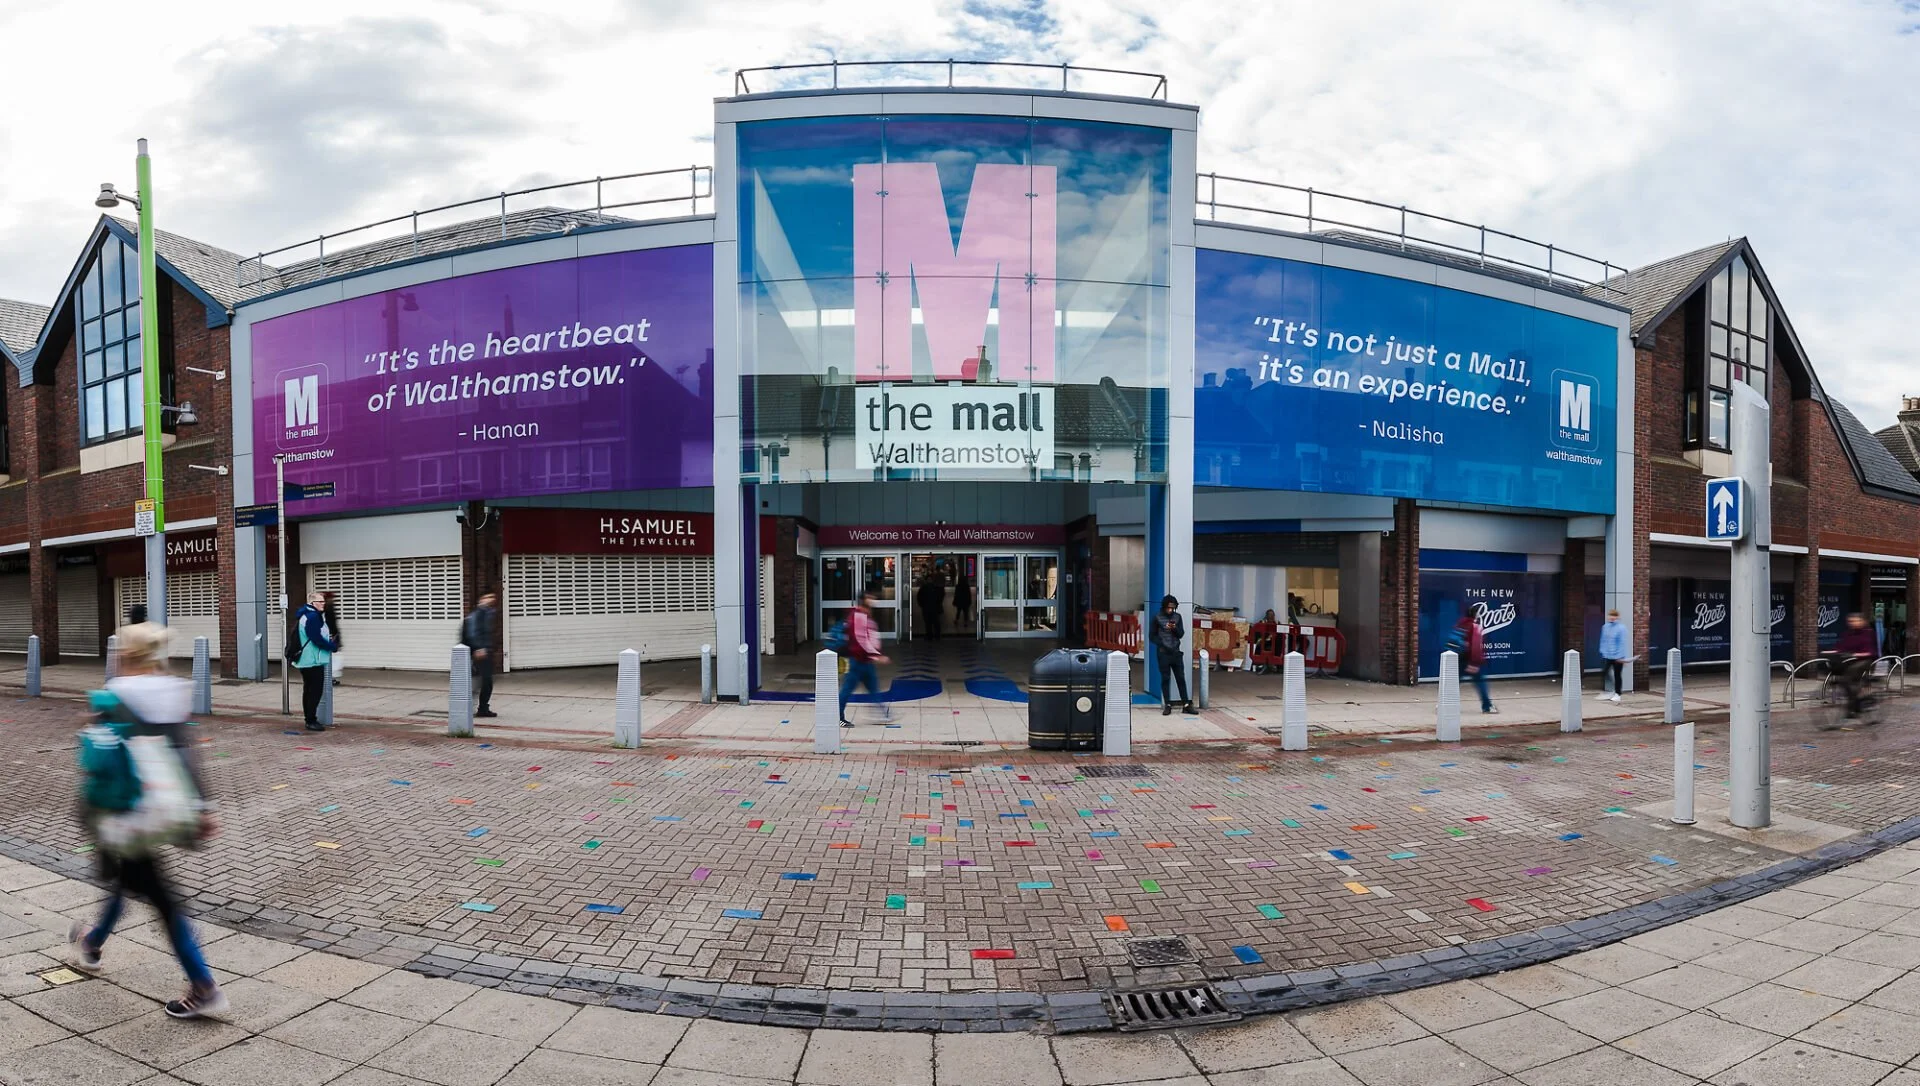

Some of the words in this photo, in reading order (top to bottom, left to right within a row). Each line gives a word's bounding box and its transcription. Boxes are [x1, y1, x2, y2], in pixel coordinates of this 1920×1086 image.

[853, 162, 1057, 383] M
[428, 339, 476, 366] the
[484, 318, 651, 359] heartbeat
[1327, 333, 1378, 357] not
[1380, 335, 1438, 366] just
[1444, 351, 1461, 371] a
[1468, 351, 1531, 387] Mall,
[367, 384, 398, 412] of
[404, 356, 648, 408] Walthamstow."
[1259, 354, 1305, 385] it's
[1313, 367, 1350, 390] an
[1358, 374, 1527, 415] experience."
[284, 374, 319, 429] M
[865, 392, 932, 432] the
[951, 392, 1044, 432] mall
[1559, 379, 1591, 431] M
[286, 429, 299, 440] the
[301, 425, 319, 438] mall
[473, 422, 539, 441] Hanan
[1373, 420, 1444, 445] Nalisha
[1559, 428, 1572, 440] the
[1573, 432, 1590, 443] mall
[271, 448, 335, 465] wlthamstow
[868, 442, 1042, 465] Walthamstow
[1545, 449, 1603, 467] walthamstow
[600, 517, 697, 536] H.SAMUEL
[848, 529, 899, 541] Welcome
[902, 529, 913, 541] to
[915, 529, 936, 541] The
[938, 529, 960, 541] Mall
[963, 529, 1035, 541] Walthamstow
[601, 536, 625, 545] THE
[633, 537, 696, 548] JEWELLER
[1466, 589, 1486, 597] THE
[1491, 589, 1514, 598] NEW
[1692, 591, 1707, 600] THE
[1709, 592, 1725, 600] NEW
[1690, 602, 1727, 630] Boots
[1494, 642, 1512, 650] SOON
